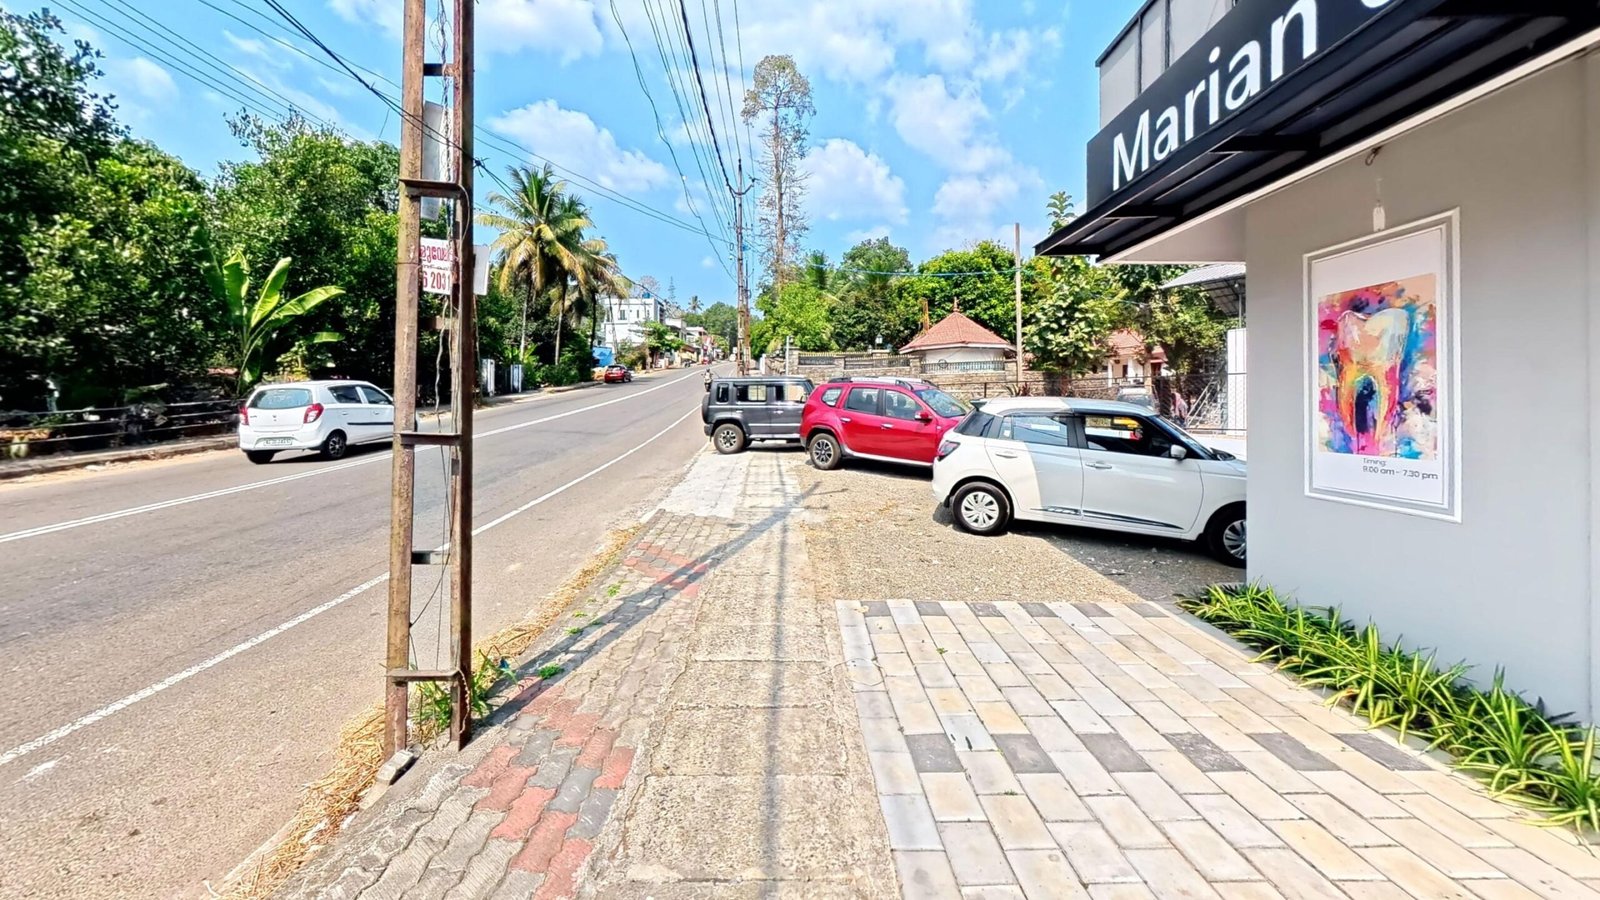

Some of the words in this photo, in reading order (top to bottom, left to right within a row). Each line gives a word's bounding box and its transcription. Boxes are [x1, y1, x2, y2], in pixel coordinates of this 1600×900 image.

[1112, 0, 1318, 191] Marian
[1363, 465, 1379, 473] 9.00
[1402, 469, 1420, 479] 7.30
